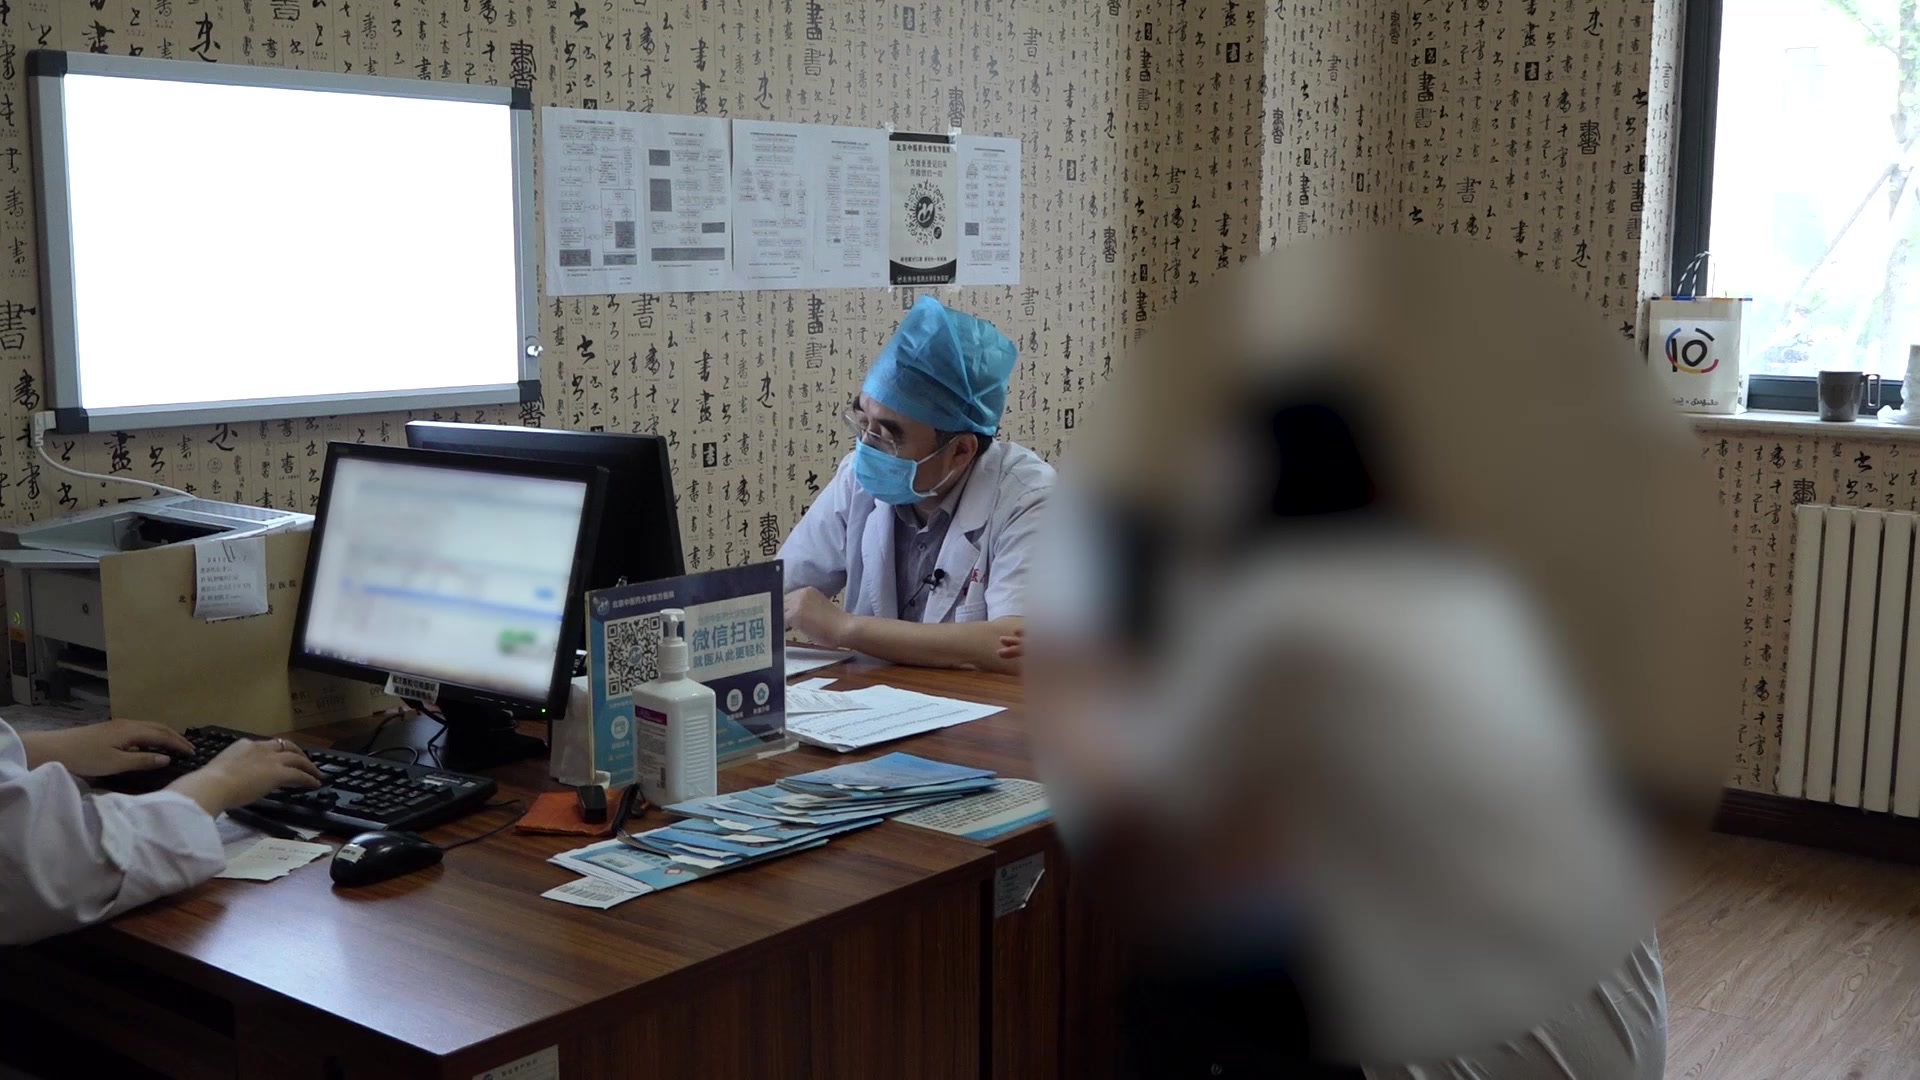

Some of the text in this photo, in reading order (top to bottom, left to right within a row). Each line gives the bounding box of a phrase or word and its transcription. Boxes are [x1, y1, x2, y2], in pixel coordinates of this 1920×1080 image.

[692, 617, 765, 651] 微信扫码
[693, 642, 765, 669] 就医从此更轻松
